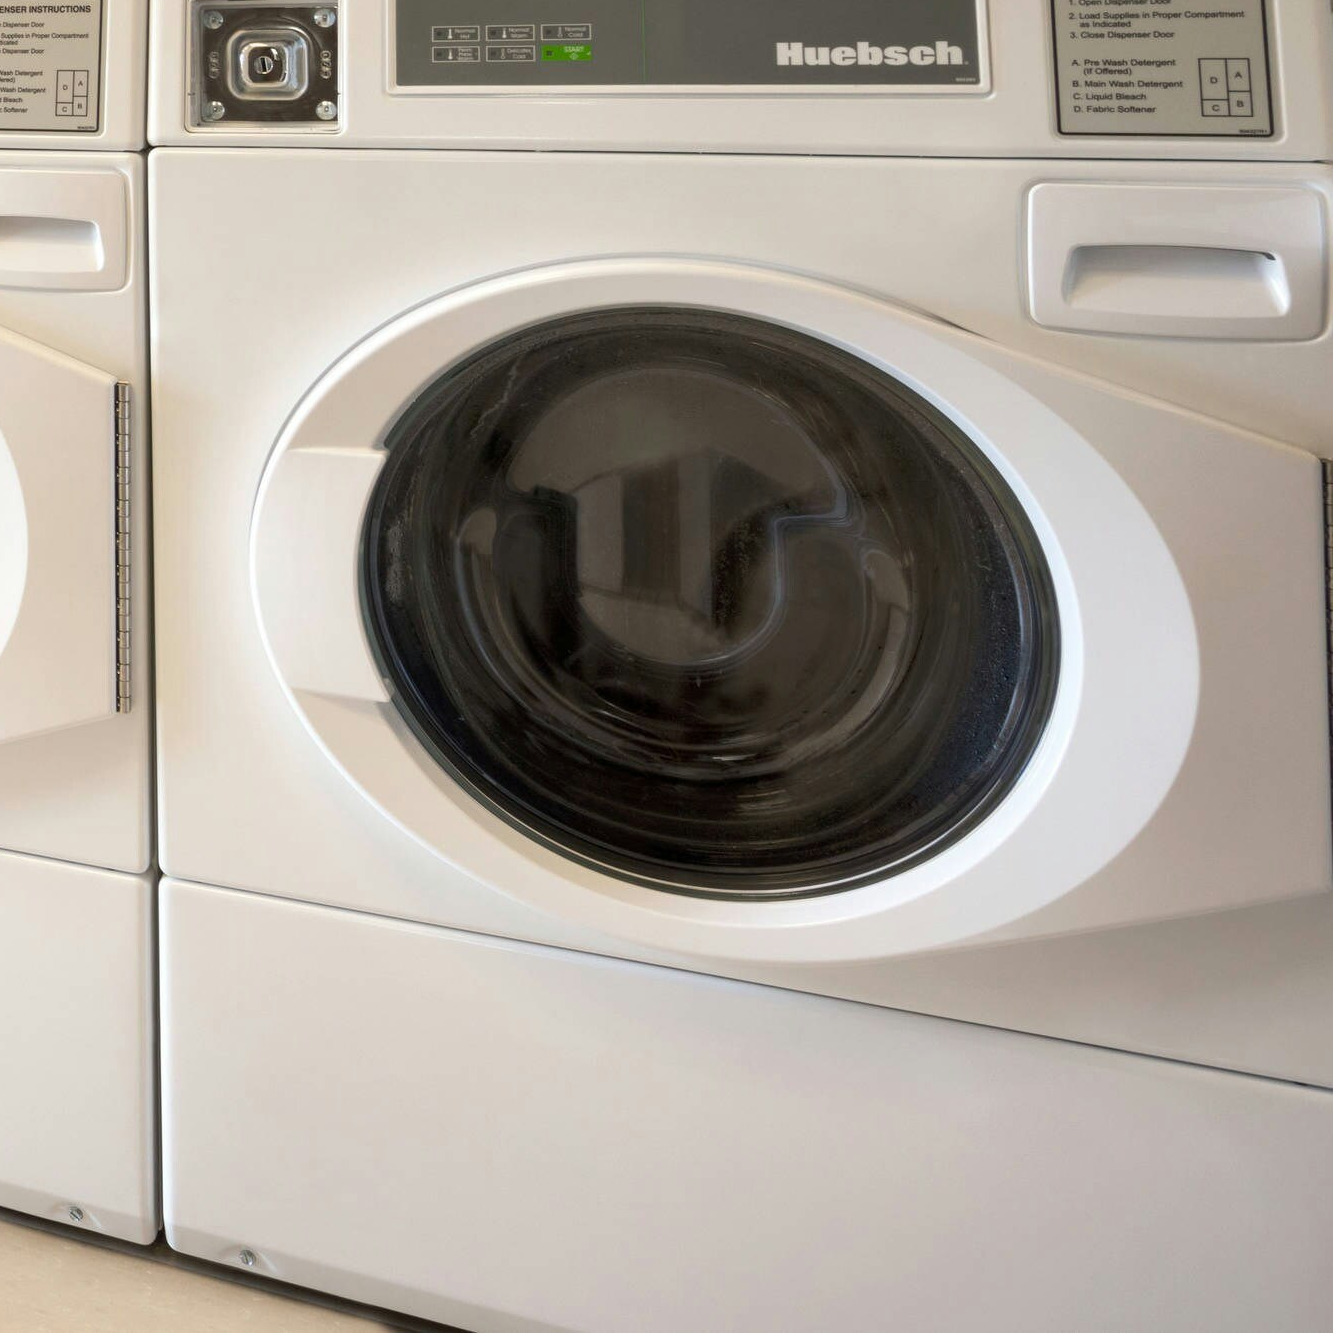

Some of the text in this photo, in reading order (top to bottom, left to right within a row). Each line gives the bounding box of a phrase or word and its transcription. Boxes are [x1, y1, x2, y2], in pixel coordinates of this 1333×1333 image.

[1078, 0, 1102, 7] Open
[29, 5, 91, 13] INSTRUCTIONS
[1103, 12, 1139, 21] Supplies
[1152, 12, 1182, 20] Proper
[1184, 11, 1245, 20] Compartment
[1107, 31, 1151, 40] Dispenser
[776, 41, 965, 66] Huebsch
[1131, 59, 1176, 68] Detergent
[1137, 81, 1183, 89] Detergent
[1086, 93, 1113, 102] Liquid
